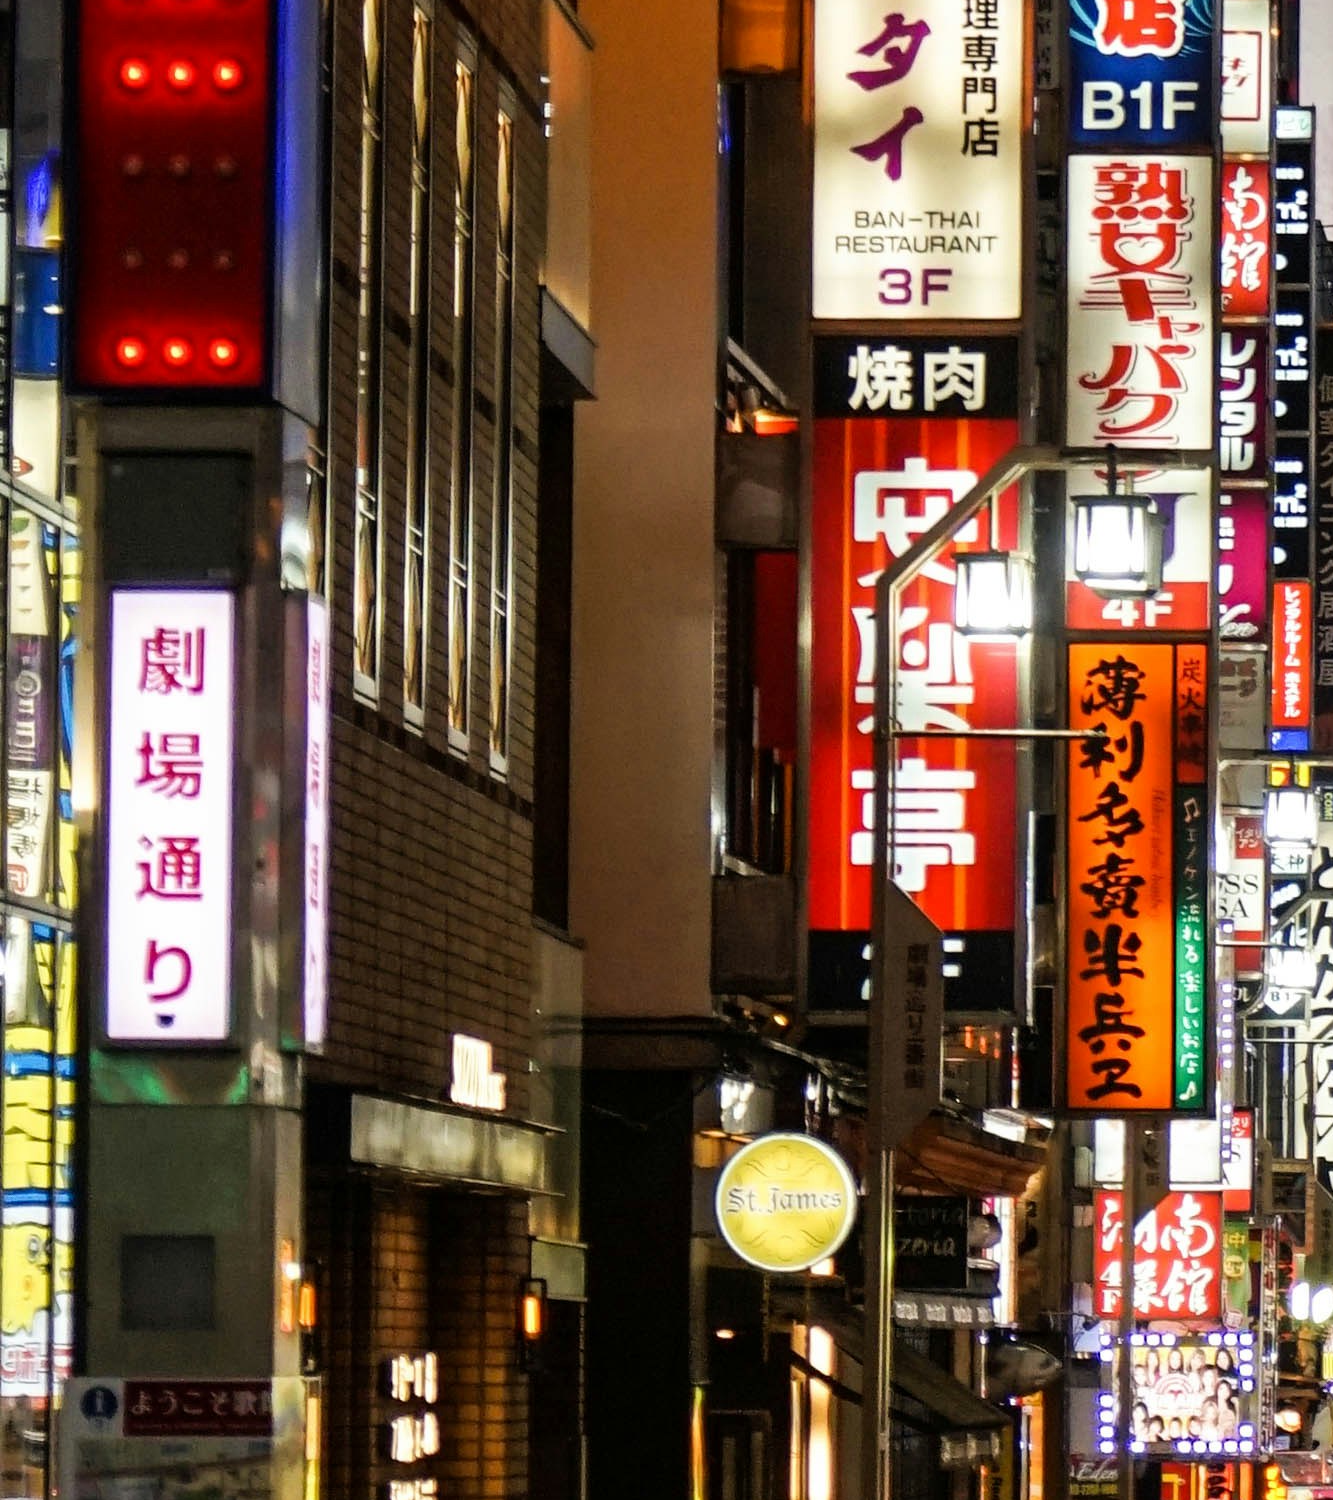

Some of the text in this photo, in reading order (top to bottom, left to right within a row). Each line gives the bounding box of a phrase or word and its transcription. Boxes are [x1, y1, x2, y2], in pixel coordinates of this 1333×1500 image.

[1082, 80, 1199, 131] B1F
[853, 209, 982, 231] BAN-THAI
[834, 234, 998, 255] RESTAURANT
[878, 268, 953, 306] 3F
[848, 346, 987, 411] 焼肉
[1101, 596, 1174, 627] 4F
[135, 627, 206, 1003] 劇場通り
[766, 1186, 843, 1215] James
